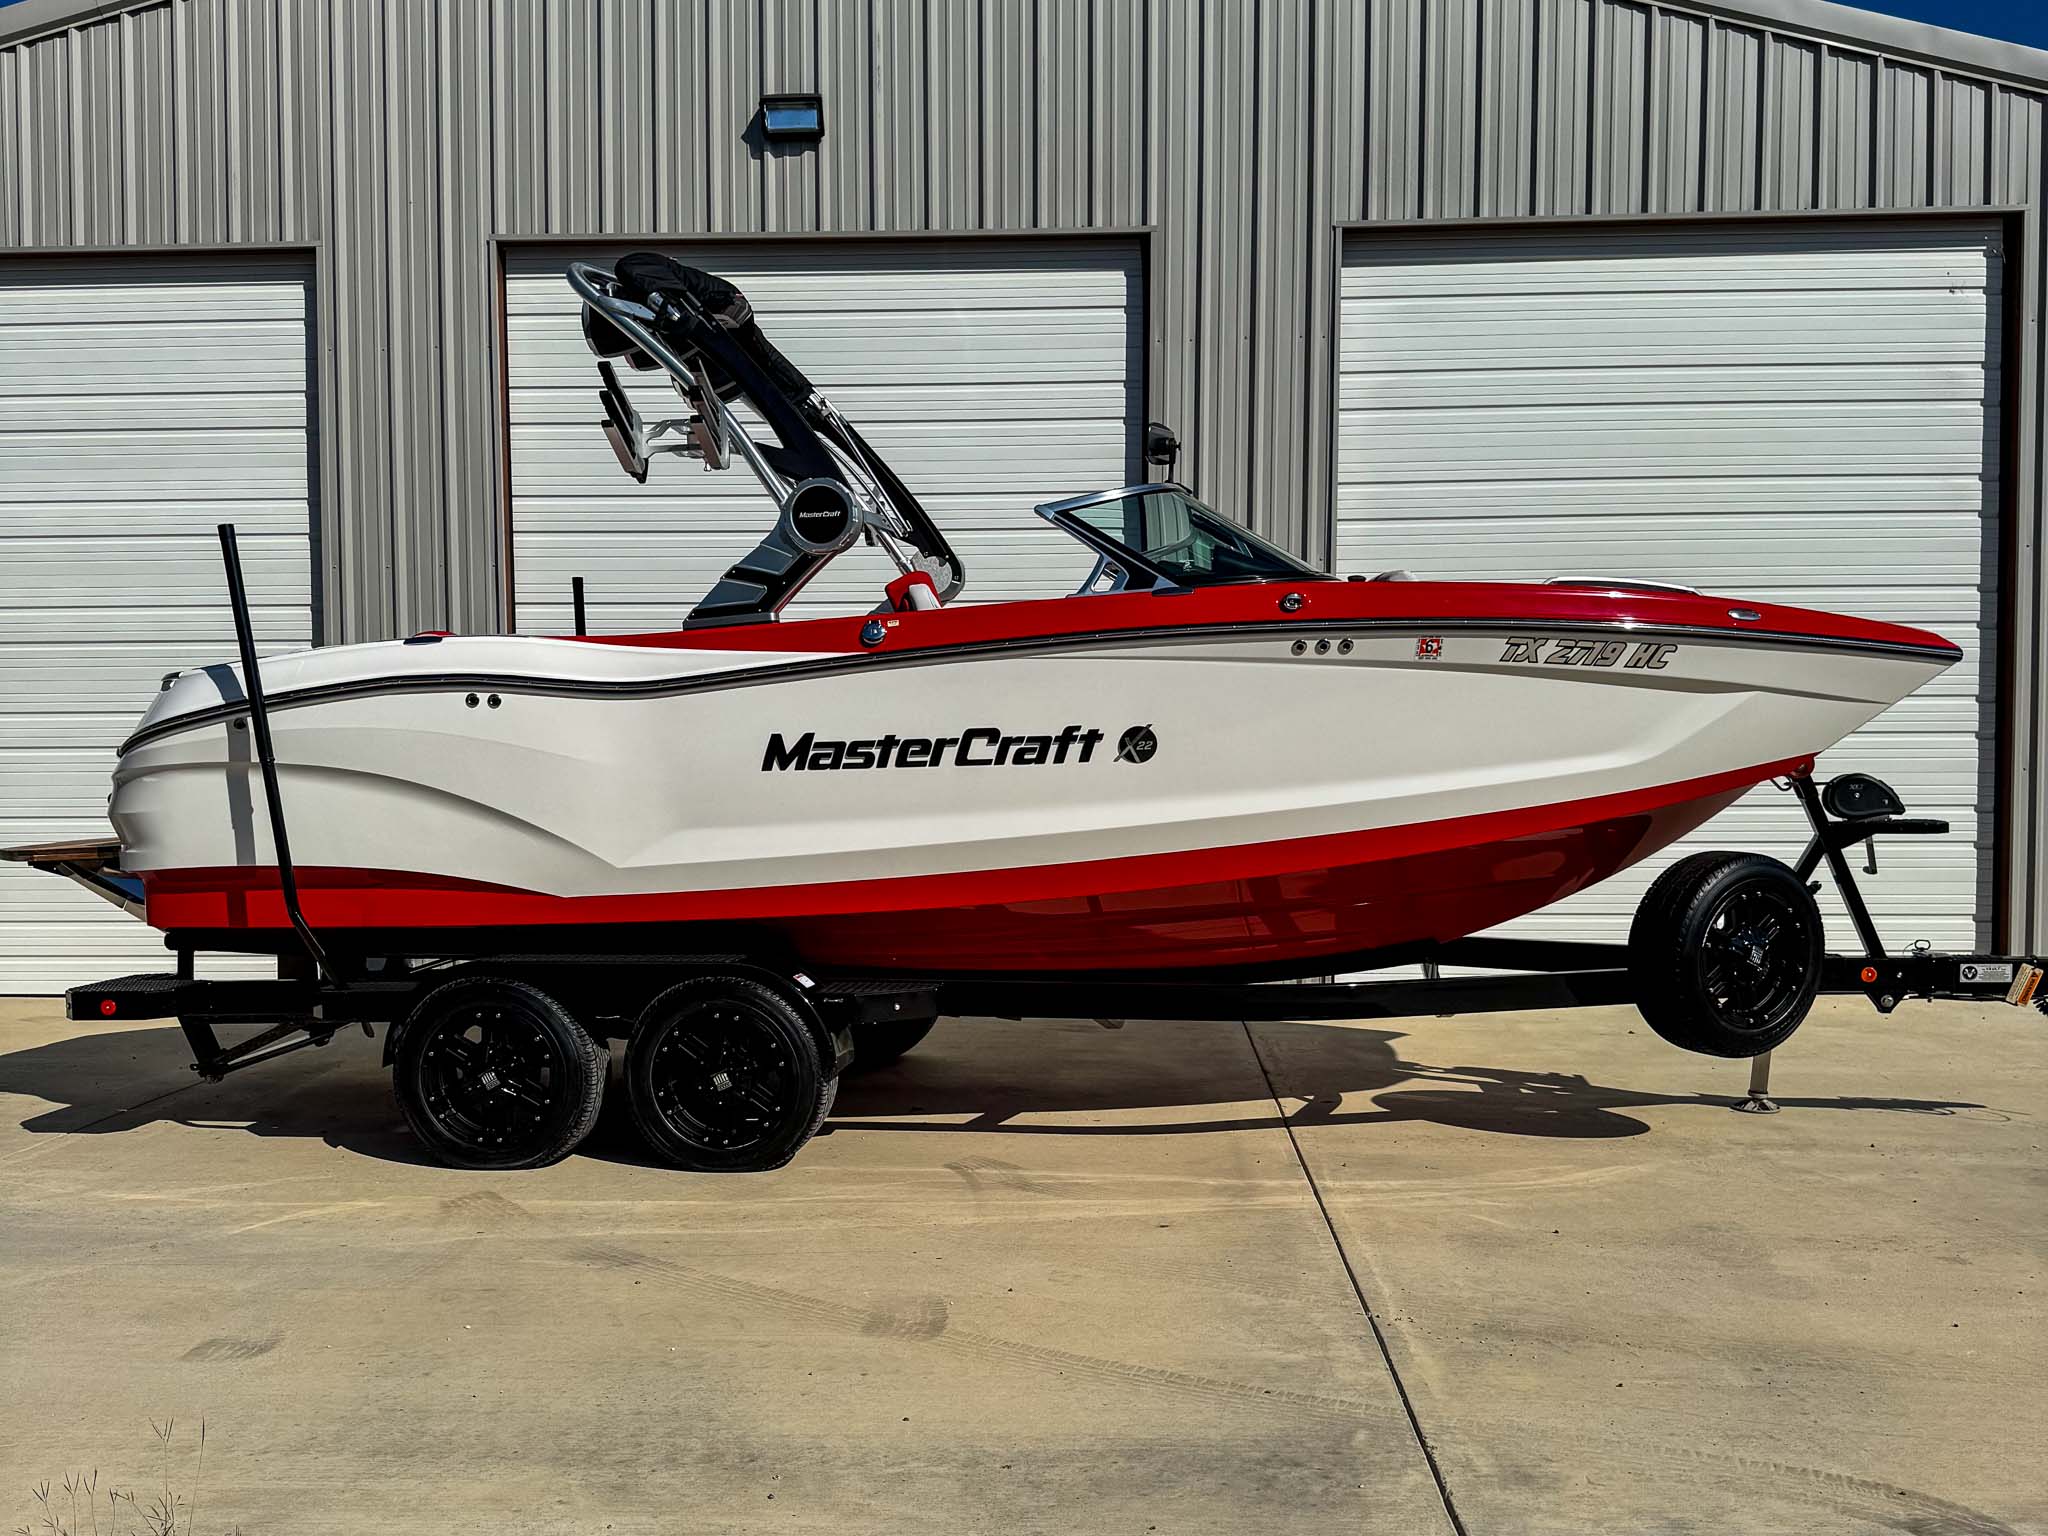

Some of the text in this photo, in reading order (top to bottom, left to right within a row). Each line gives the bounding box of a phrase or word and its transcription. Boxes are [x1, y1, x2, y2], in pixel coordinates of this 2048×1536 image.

[799, 510, 840, 518] MasterCraft
[1425, 639, 1434, 653] 6
[1499, 636, 1678, 669] TX 2719 HC
[761, 725, 1104, 772] MasterCraft
